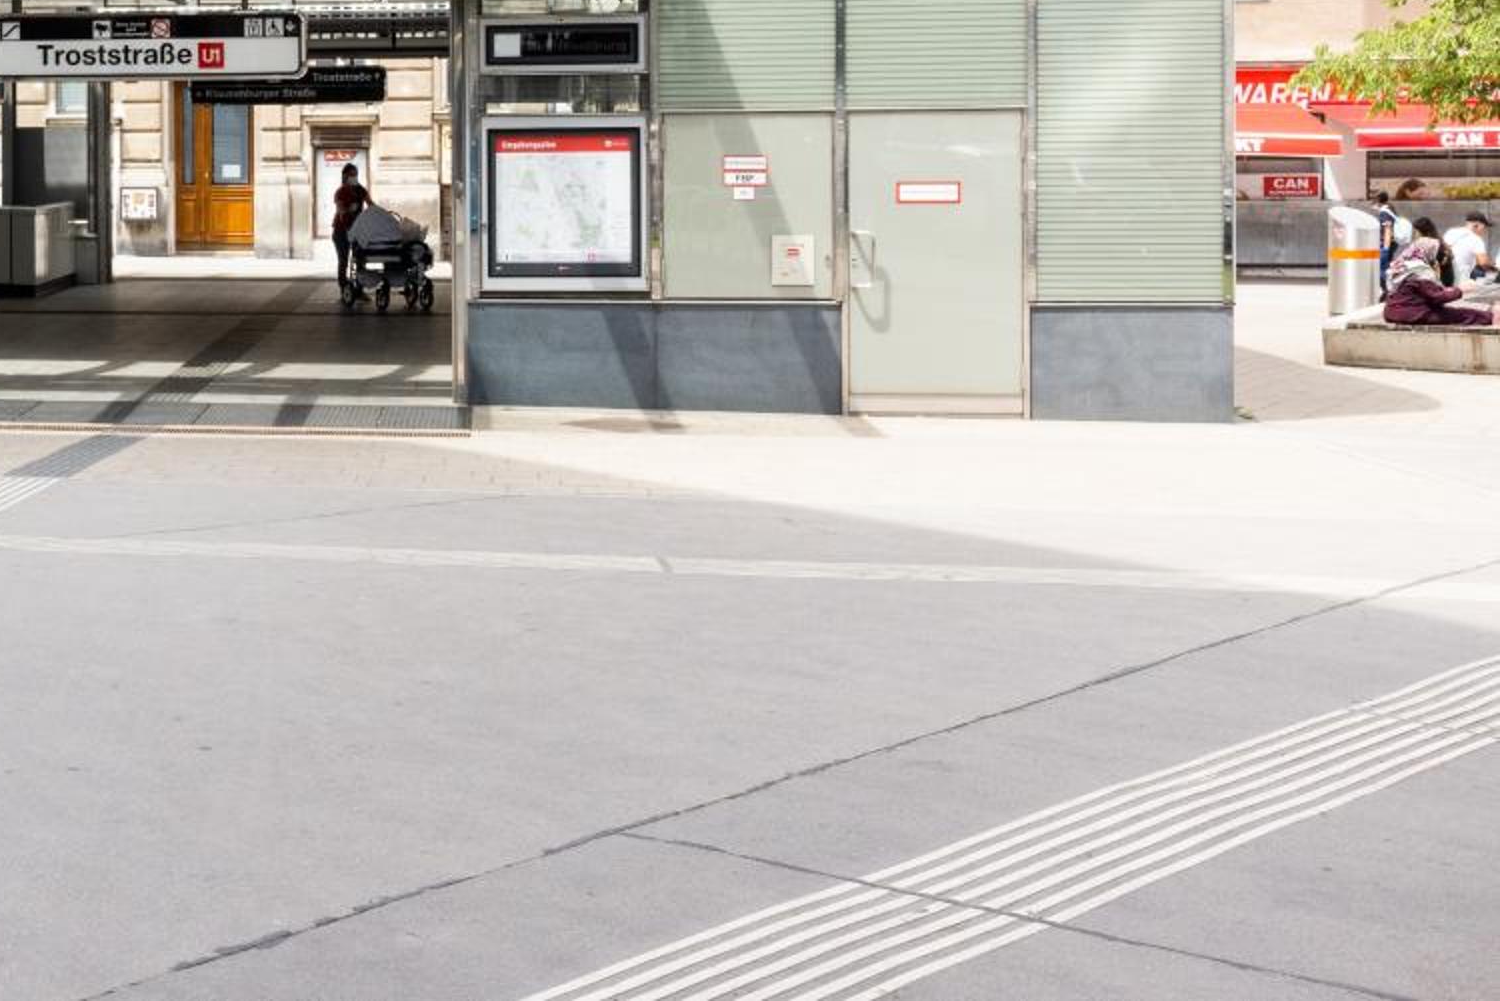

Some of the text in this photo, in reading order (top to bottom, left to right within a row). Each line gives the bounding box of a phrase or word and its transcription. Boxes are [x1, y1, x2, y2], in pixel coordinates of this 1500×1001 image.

[36, 43, 222, 67] Troststraße U1
[1440, 132, 1484, 146] CAN
[1273, 178, 1309, 190] CAN
